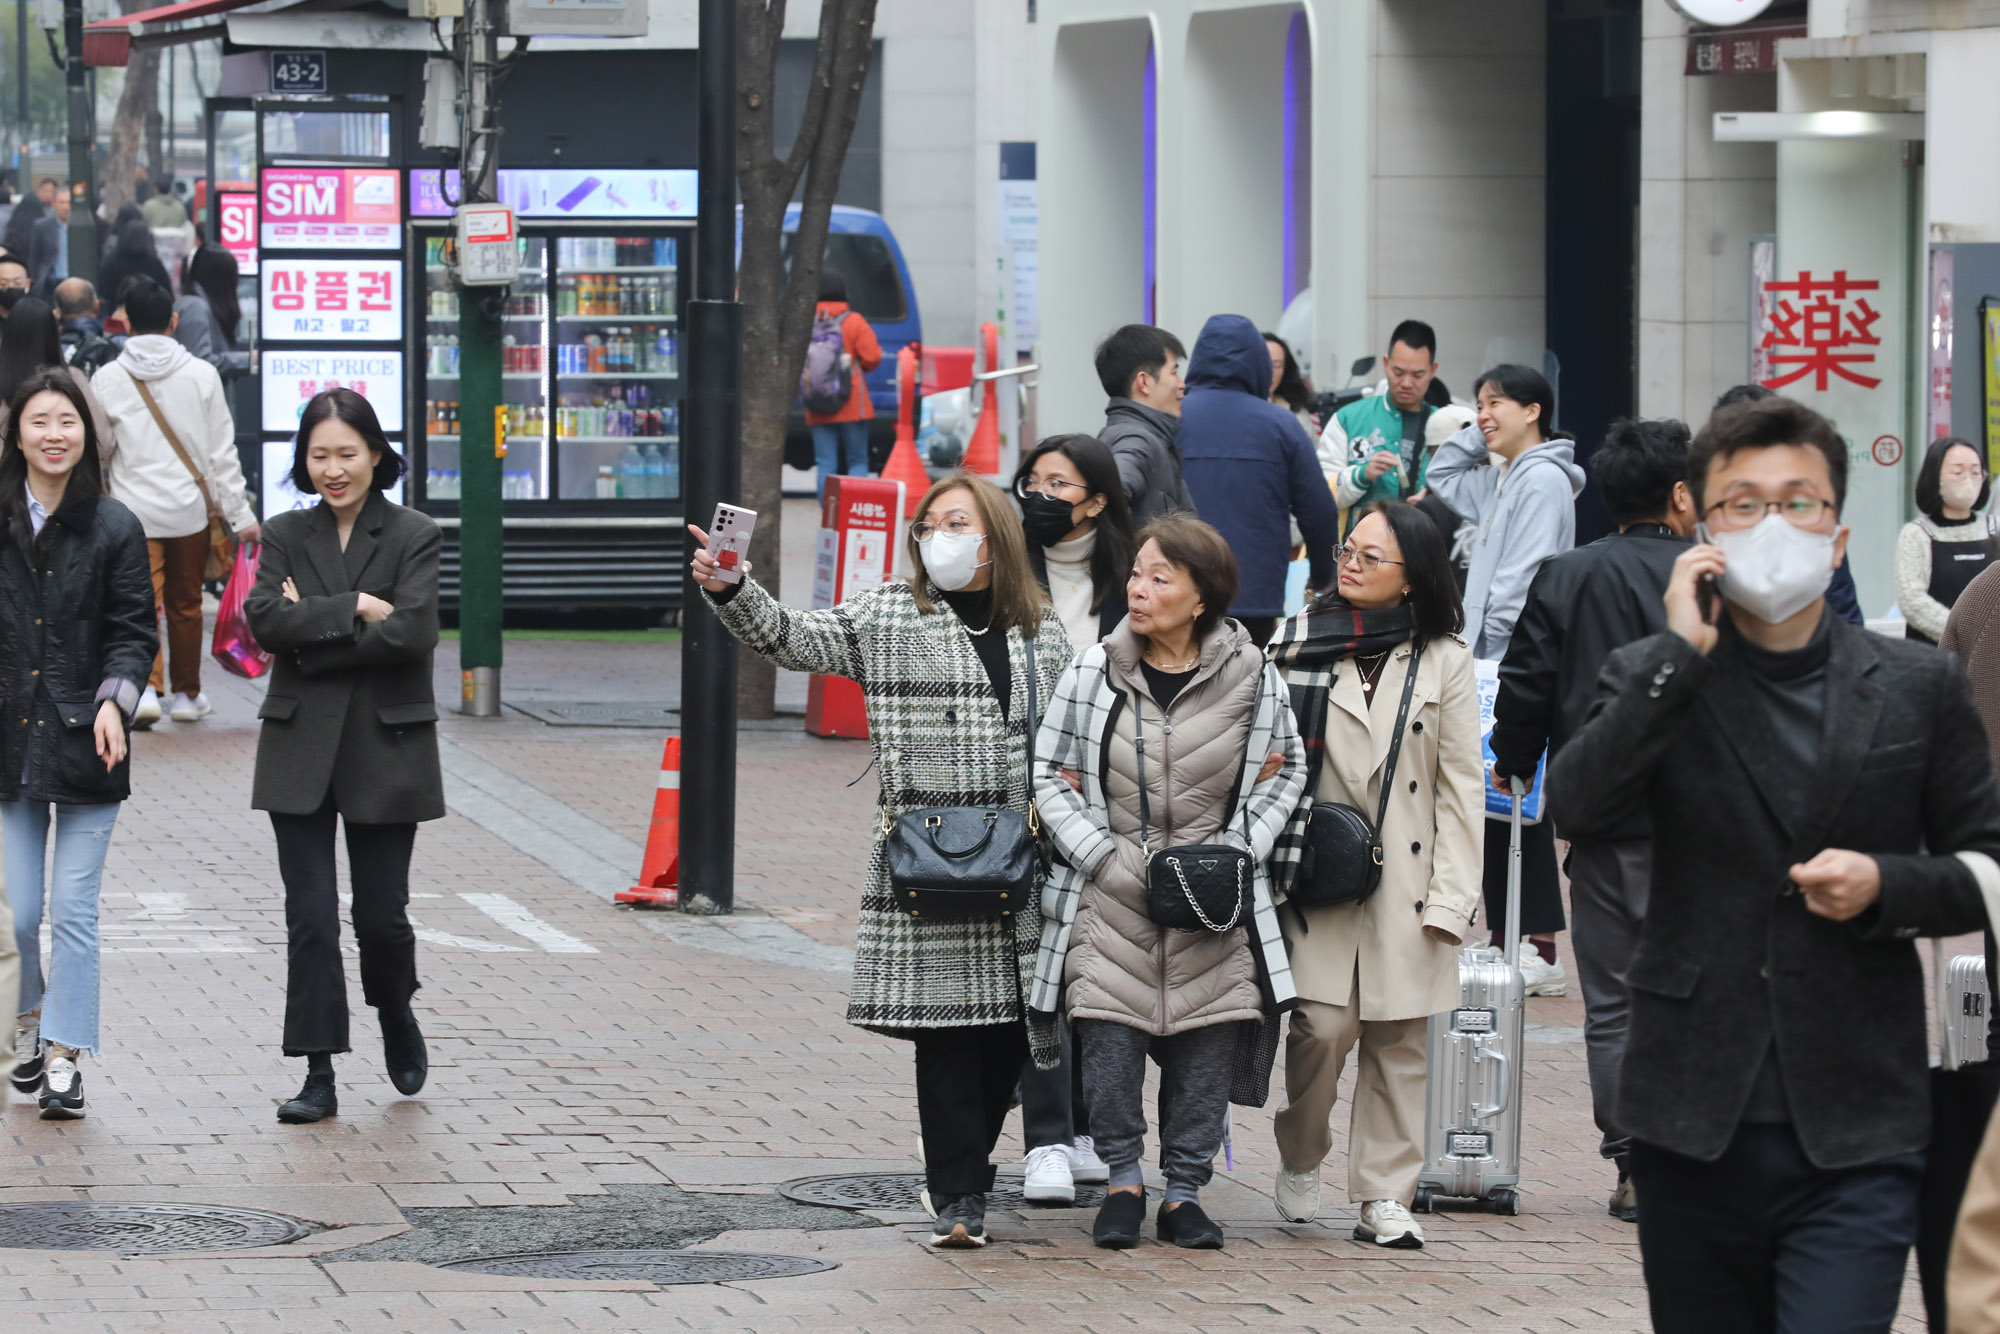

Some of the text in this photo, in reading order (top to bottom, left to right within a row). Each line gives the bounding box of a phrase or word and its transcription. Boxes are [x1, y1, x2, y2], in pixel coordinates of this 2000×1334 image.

[276, 64, 320, 82] 43-2
[266, 182, 336, 216] SIM
[221, 206, 254, 242] SI
[270, 271, 392, 311] 상품권
[294, 318, 323, 332] 사고
[1760, 270, 1883, 391] 藥
[272, 358, 394, 376] BEST PRICE
[850, 502, 886, 518] 사용법
